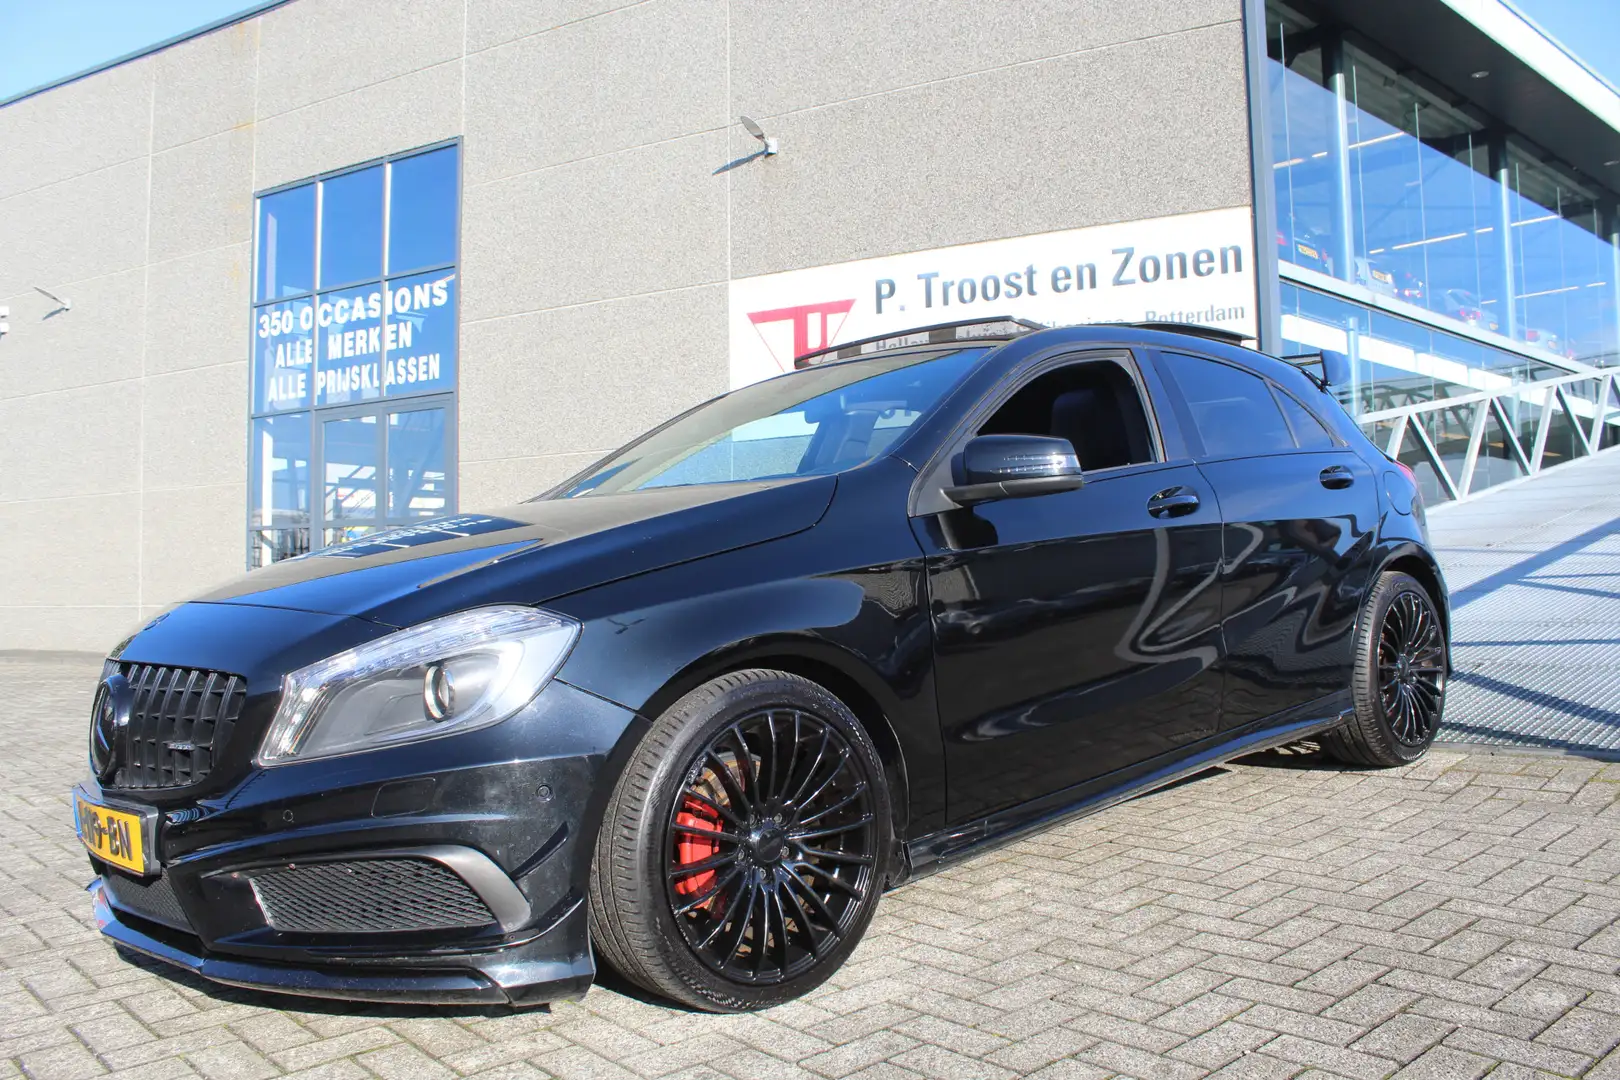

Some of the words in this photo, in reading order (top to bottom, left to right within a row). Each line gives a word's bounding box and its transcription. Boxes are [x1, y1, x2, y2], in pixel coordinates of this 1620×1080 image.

[875, 278, 905, 314] P.
[917, 263, 1037, 308] Troost
[1050, 265, 1097, 293] en
[1111, 244, 1243, 286] Zonen
[258, 310, 294, 339] 350
[300, 279, 448, 330] OCCASIONS
[1145, 304, 1245, 325] Rotterdam
[275, 339, 313, 369] ALLE
[327, 321, 412, 360] MERKEN
[268, 373, 306, 402] ALLE
[317, 353, 440, 395] PRIJSKLASSEN
